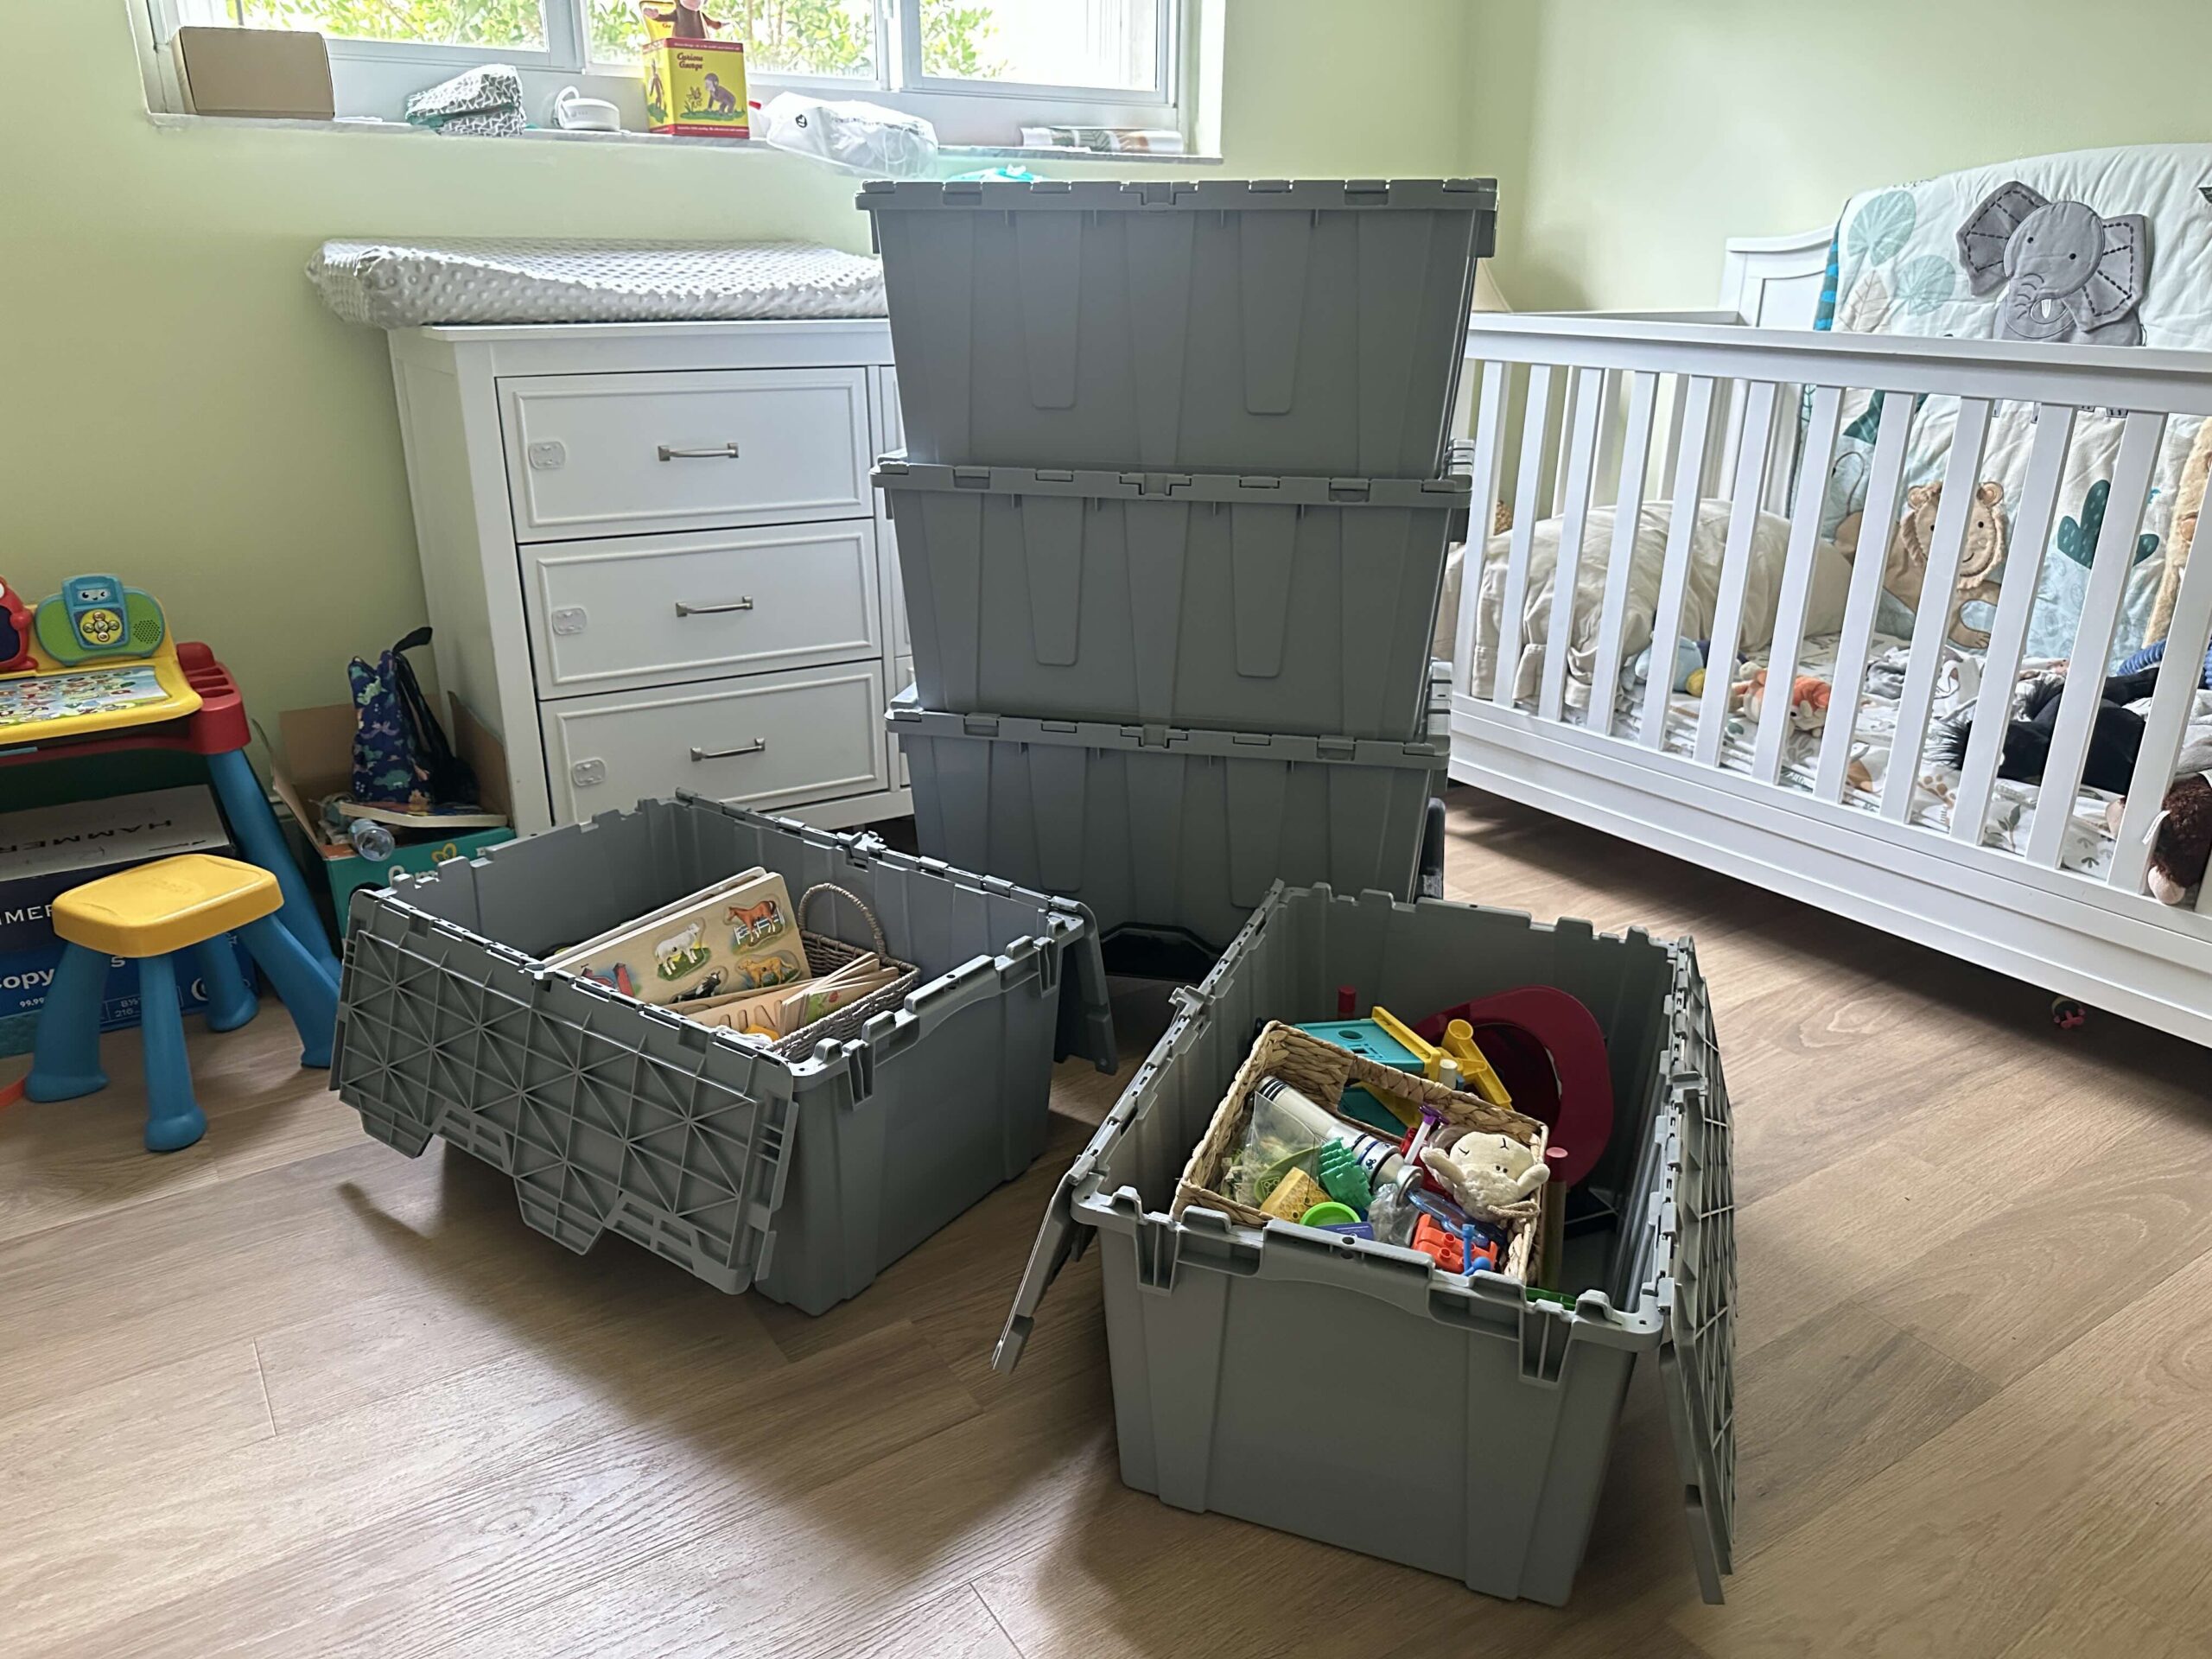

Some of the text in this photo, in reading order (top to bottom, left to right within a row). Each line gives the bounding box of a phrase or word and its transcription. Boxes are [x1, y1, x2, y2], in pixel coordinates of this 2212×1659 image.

[677, 52, 703, 61] Curious
[679, 60, 703, 72] George
[0, 969, 54, 989] opy
